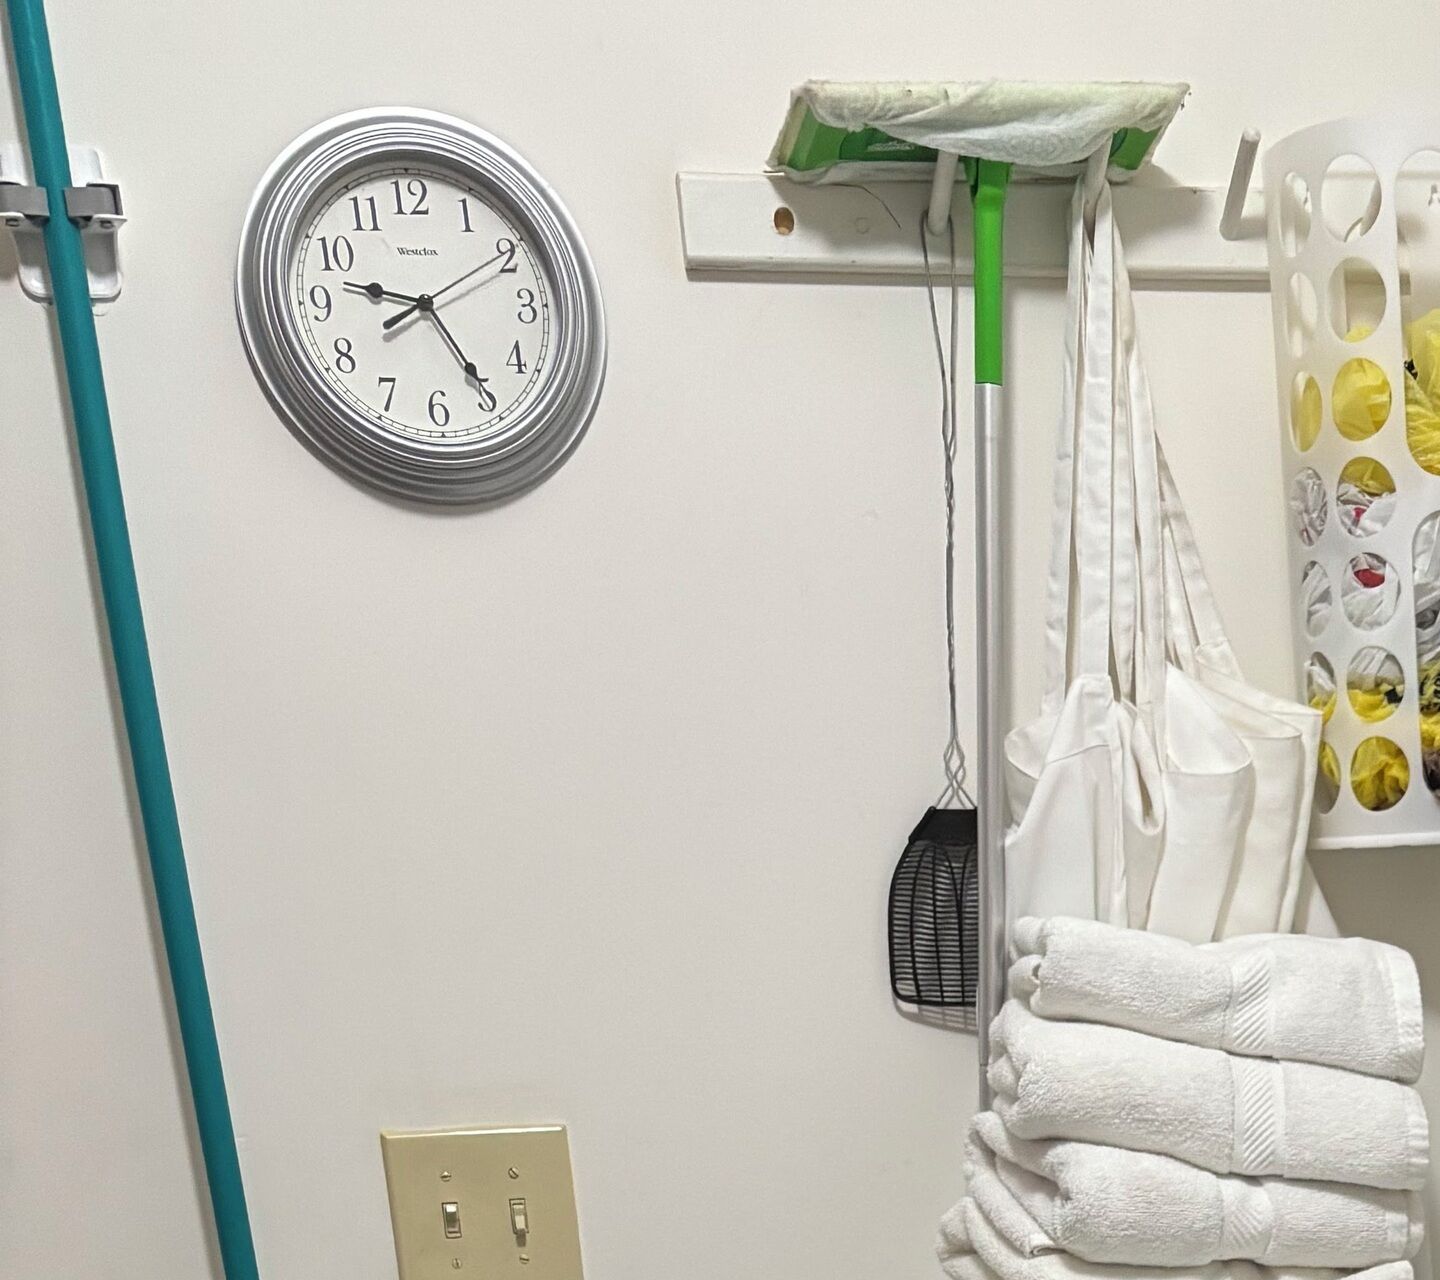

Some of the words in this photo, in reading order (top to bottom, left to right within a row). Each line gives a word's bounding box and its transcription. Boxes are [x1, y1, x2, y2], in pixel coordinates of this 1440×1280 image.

[348, 196, 382, 231] 11
[390, 179, 430, 215] 12
[457, 198, 475, 232] 1
[316, 235, 354, 272] 10
[496, 238, 518, 273] 2
[308, 285, 332, 321] 9
[516, 288, 538, 324] 3
[333, 337, 356, 373] 8
[506, 340, 527, 374] 4
[378, 377, 397, 412] 7
[428, 390, 450, 427] 6
[477, 376, 497, 412] 5
